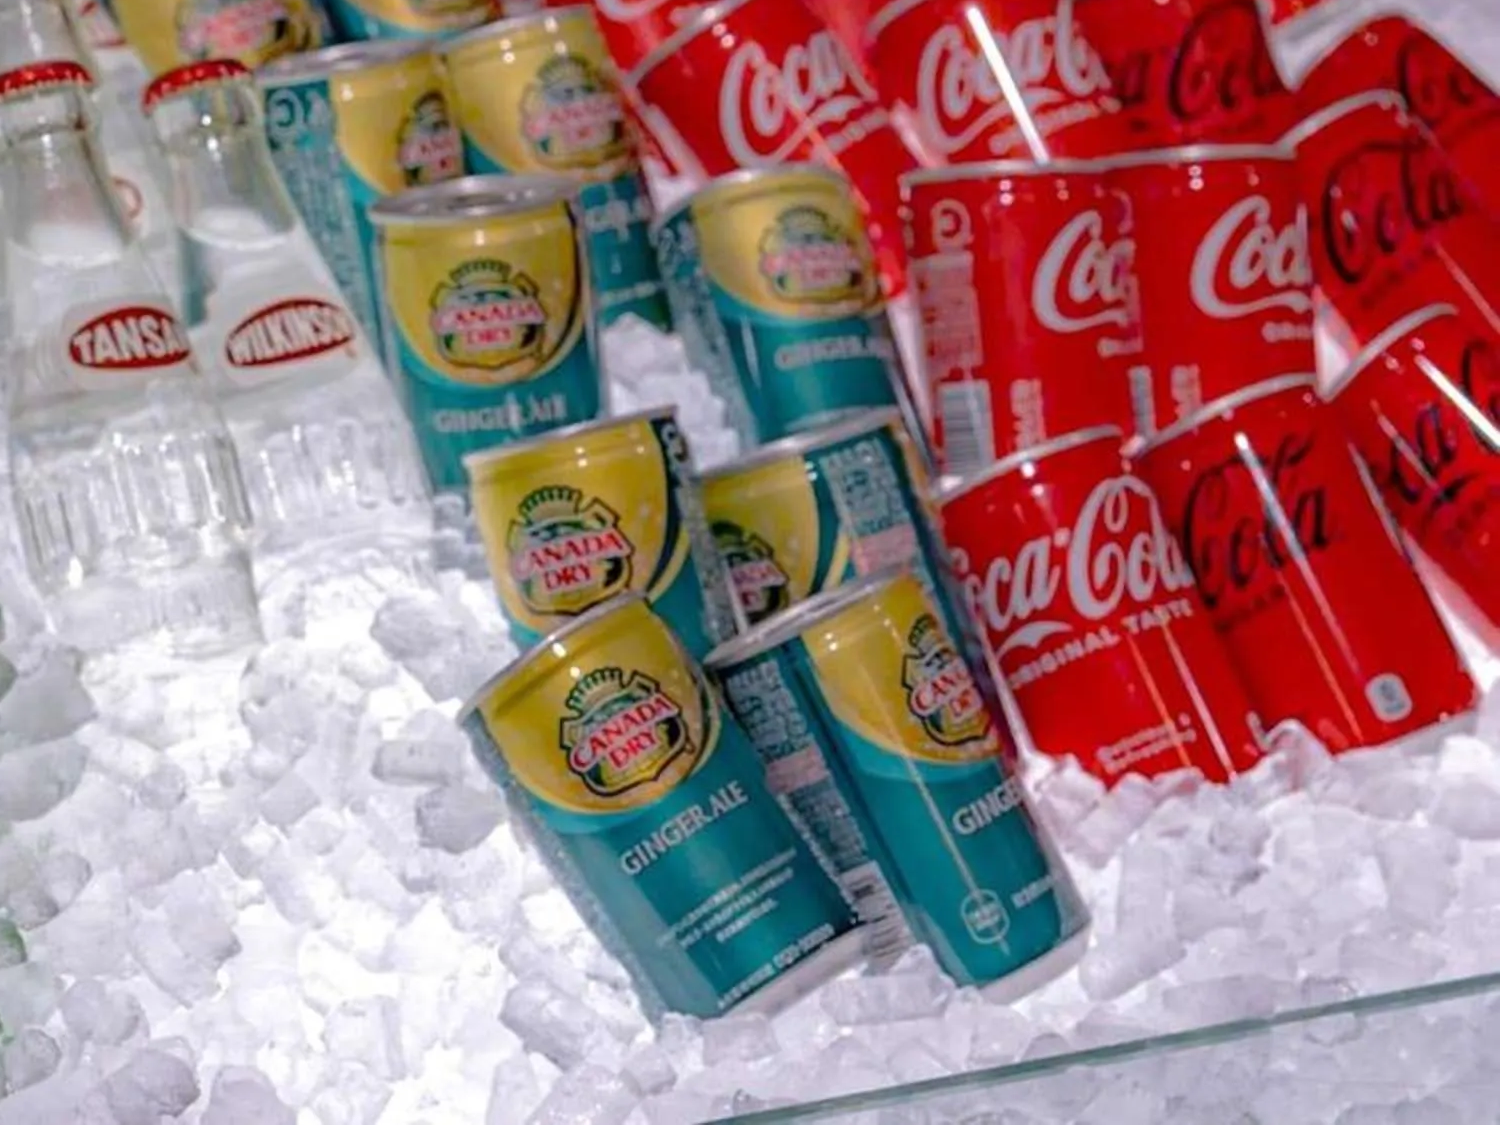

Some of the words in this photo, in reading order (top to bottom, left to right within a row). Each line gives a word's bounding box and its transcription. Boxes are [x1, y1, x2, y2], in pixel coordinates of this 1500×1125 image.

[540, 561, 593, 594] DRY
[570, 693, 677, 772] CANADA
[608, 728, 661, 771] DRY
[620, 808, 711, 876] GINGER
[709, 779, 750, 820] ALE
